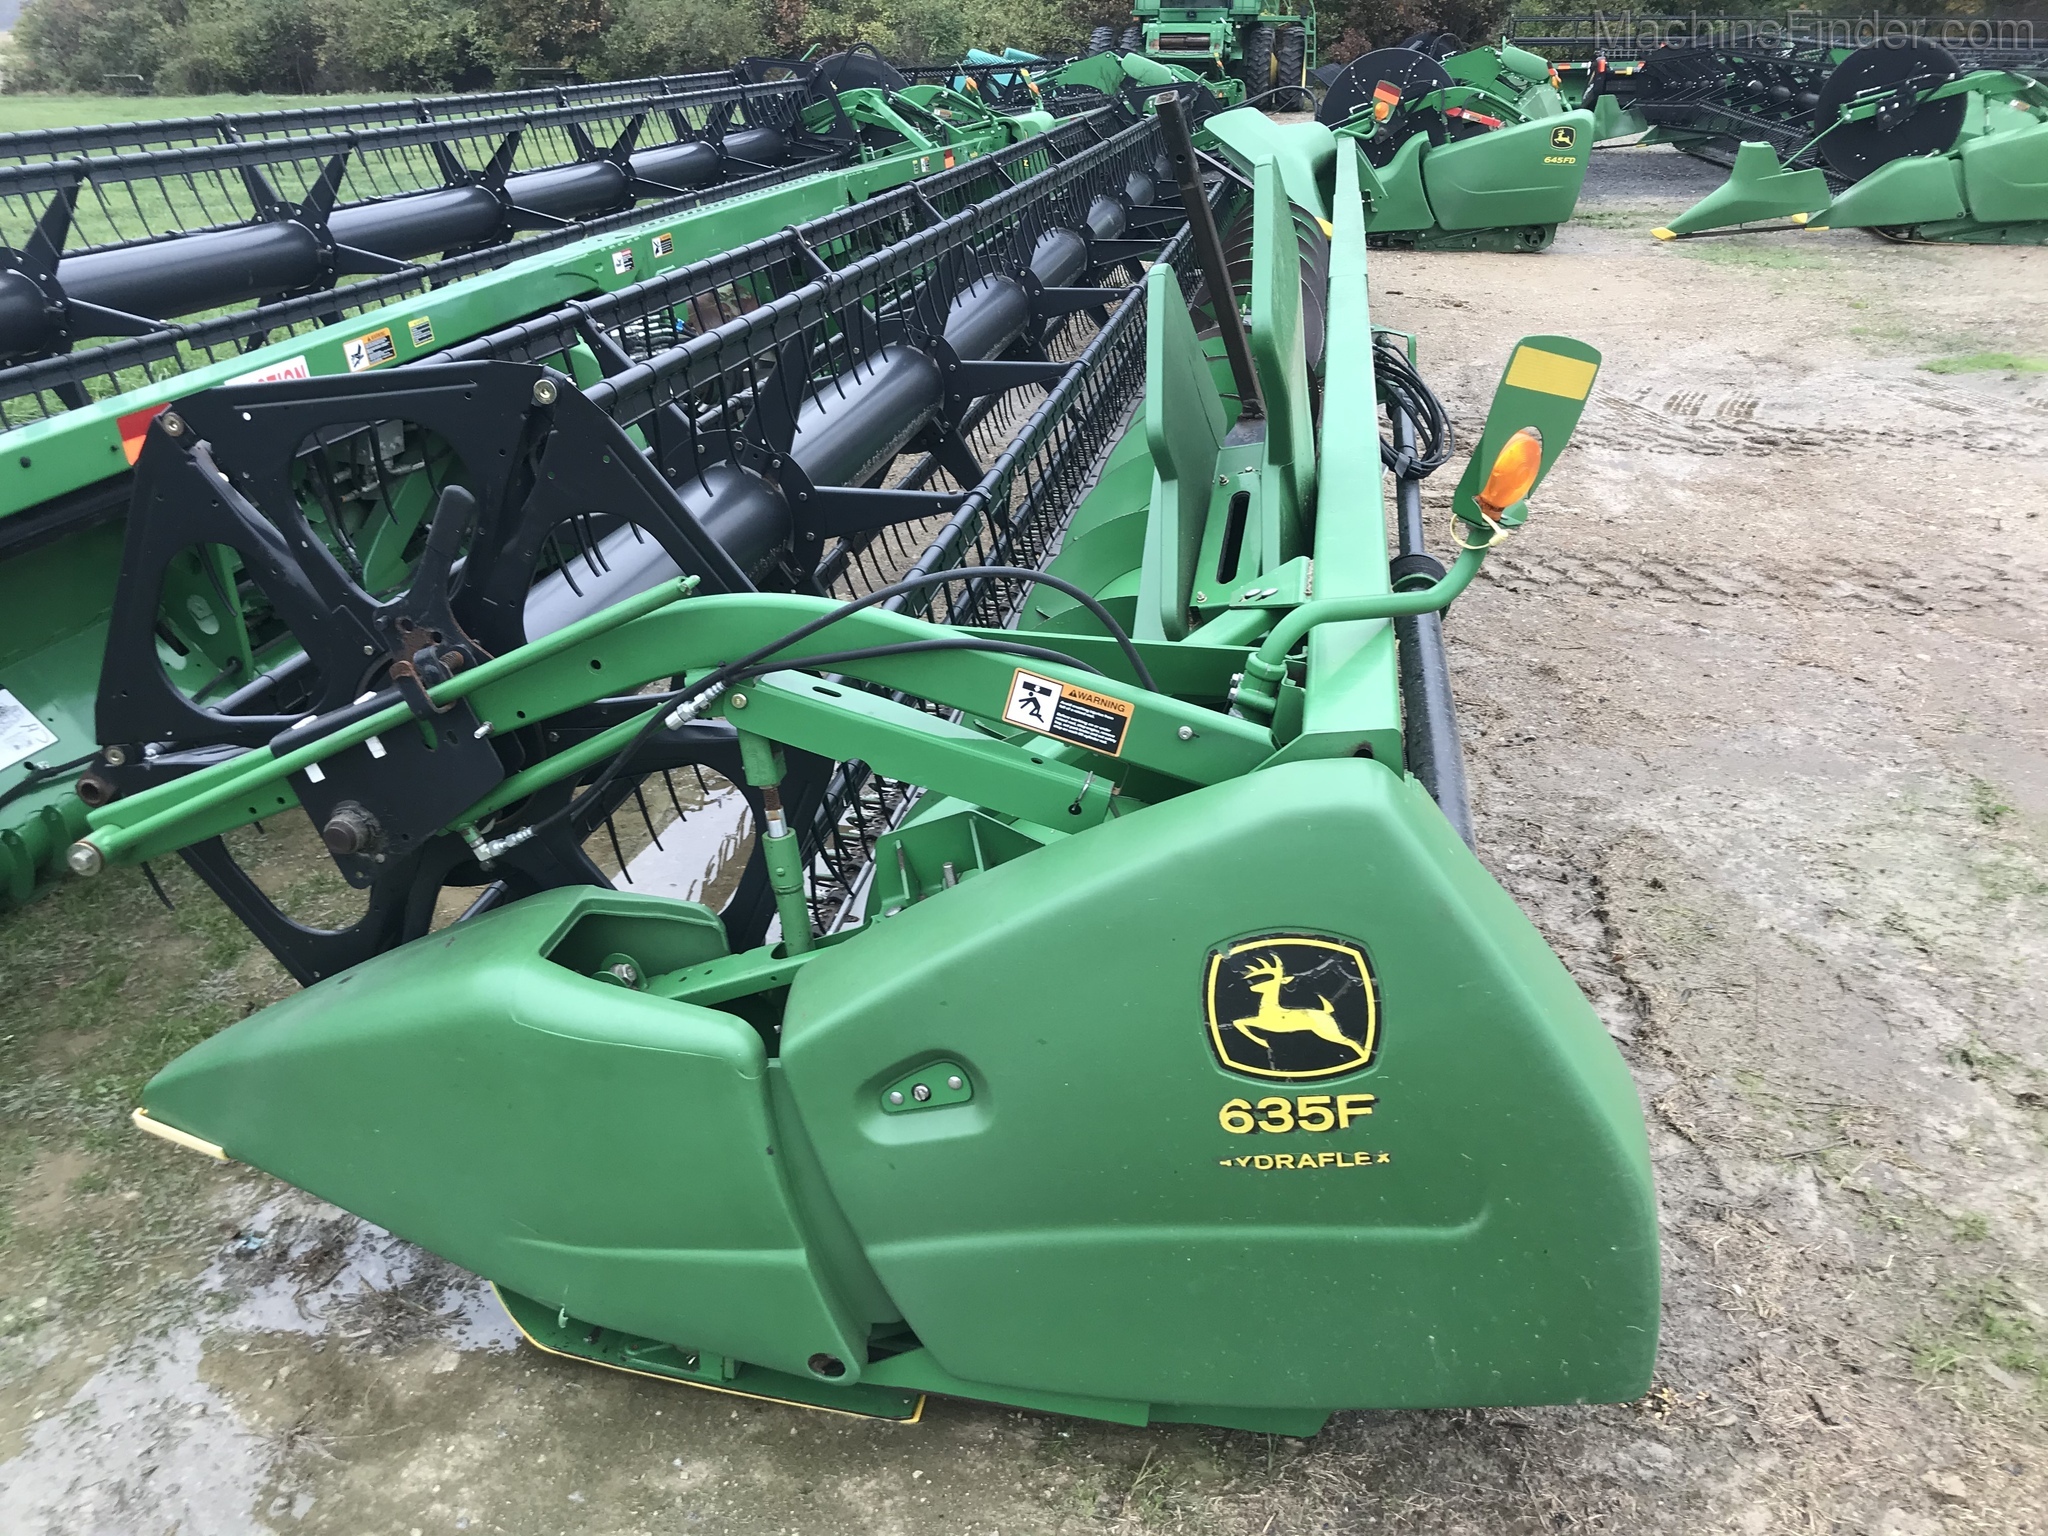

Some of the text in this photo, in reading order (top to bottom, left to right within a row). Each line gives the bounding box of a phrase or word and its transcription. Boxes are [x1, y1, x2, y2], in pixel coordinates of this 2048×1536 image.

[1544, 156, 1576, 164] 645FD
[1078, 690, 1126, 713] WARNING
[1219, 1093, 1376, 1134] 635F
